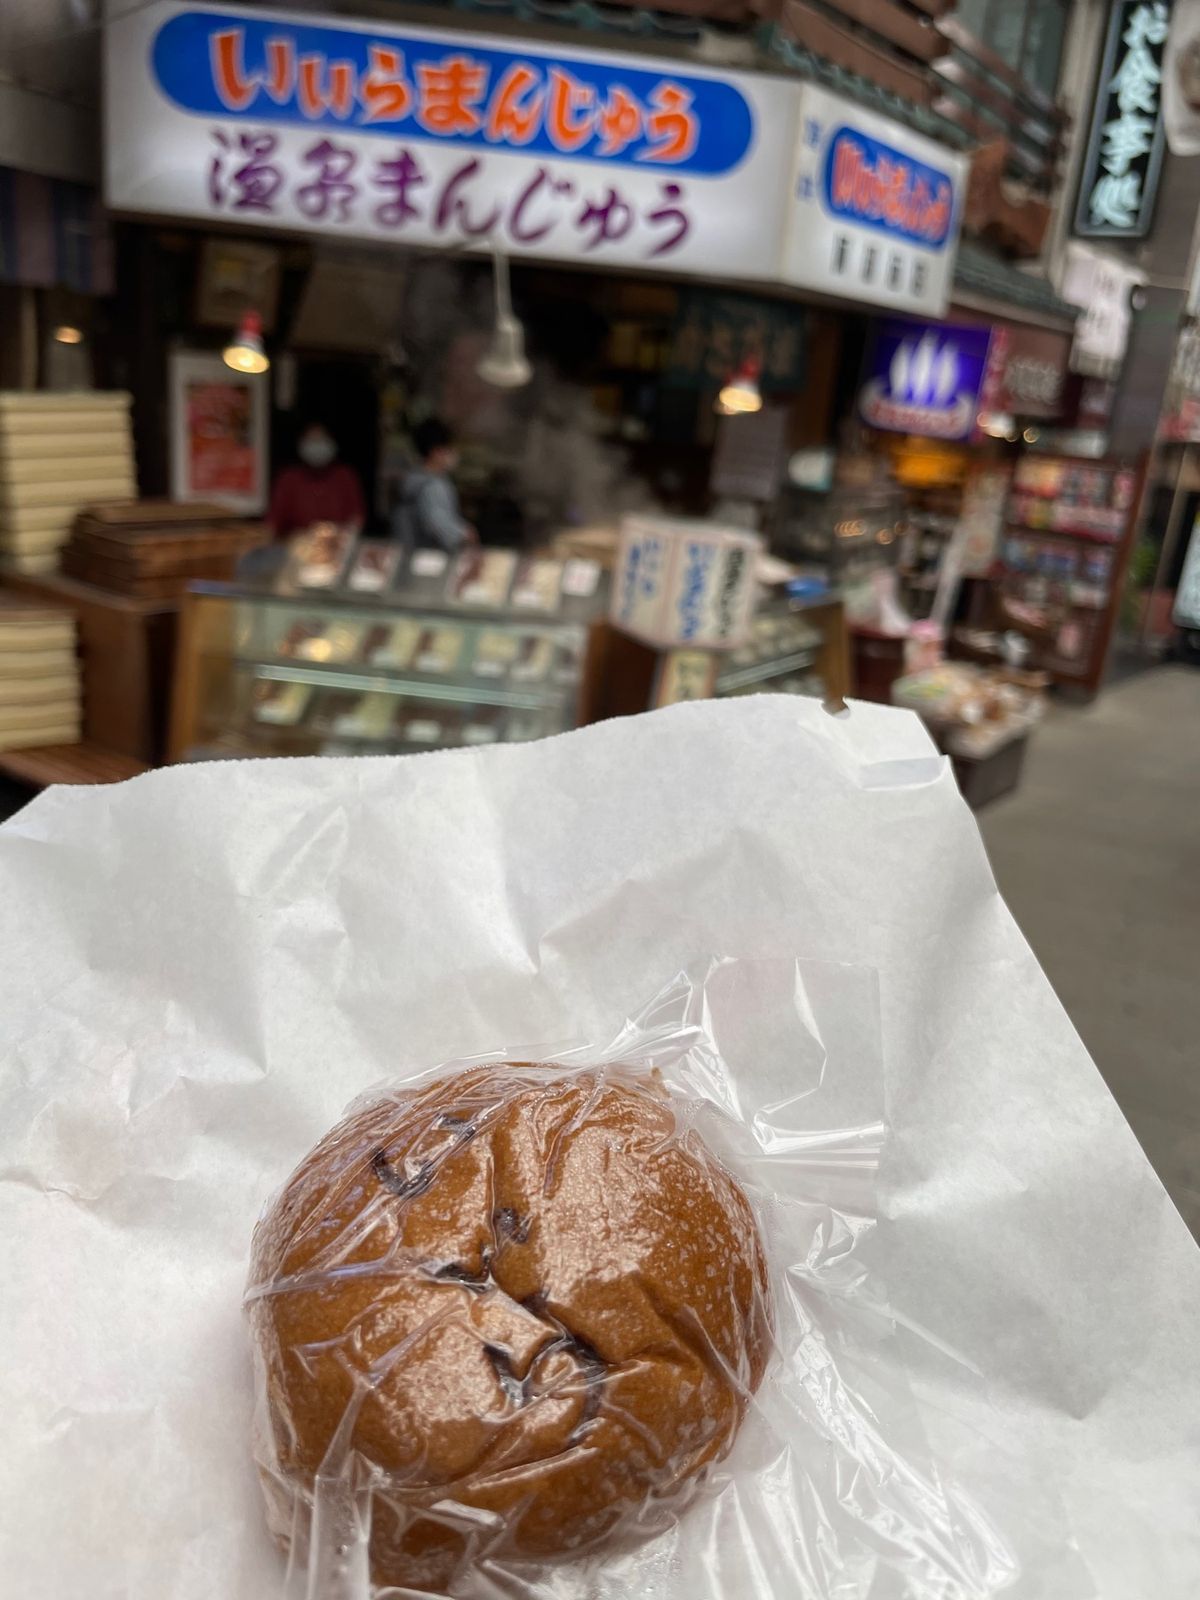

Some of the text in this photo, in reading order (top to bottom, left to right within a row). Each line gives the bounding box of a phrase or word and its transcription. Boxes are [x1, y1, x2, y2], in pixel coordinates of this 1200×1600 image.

[209, 131, 689, 255] 温泉まんじゅう
